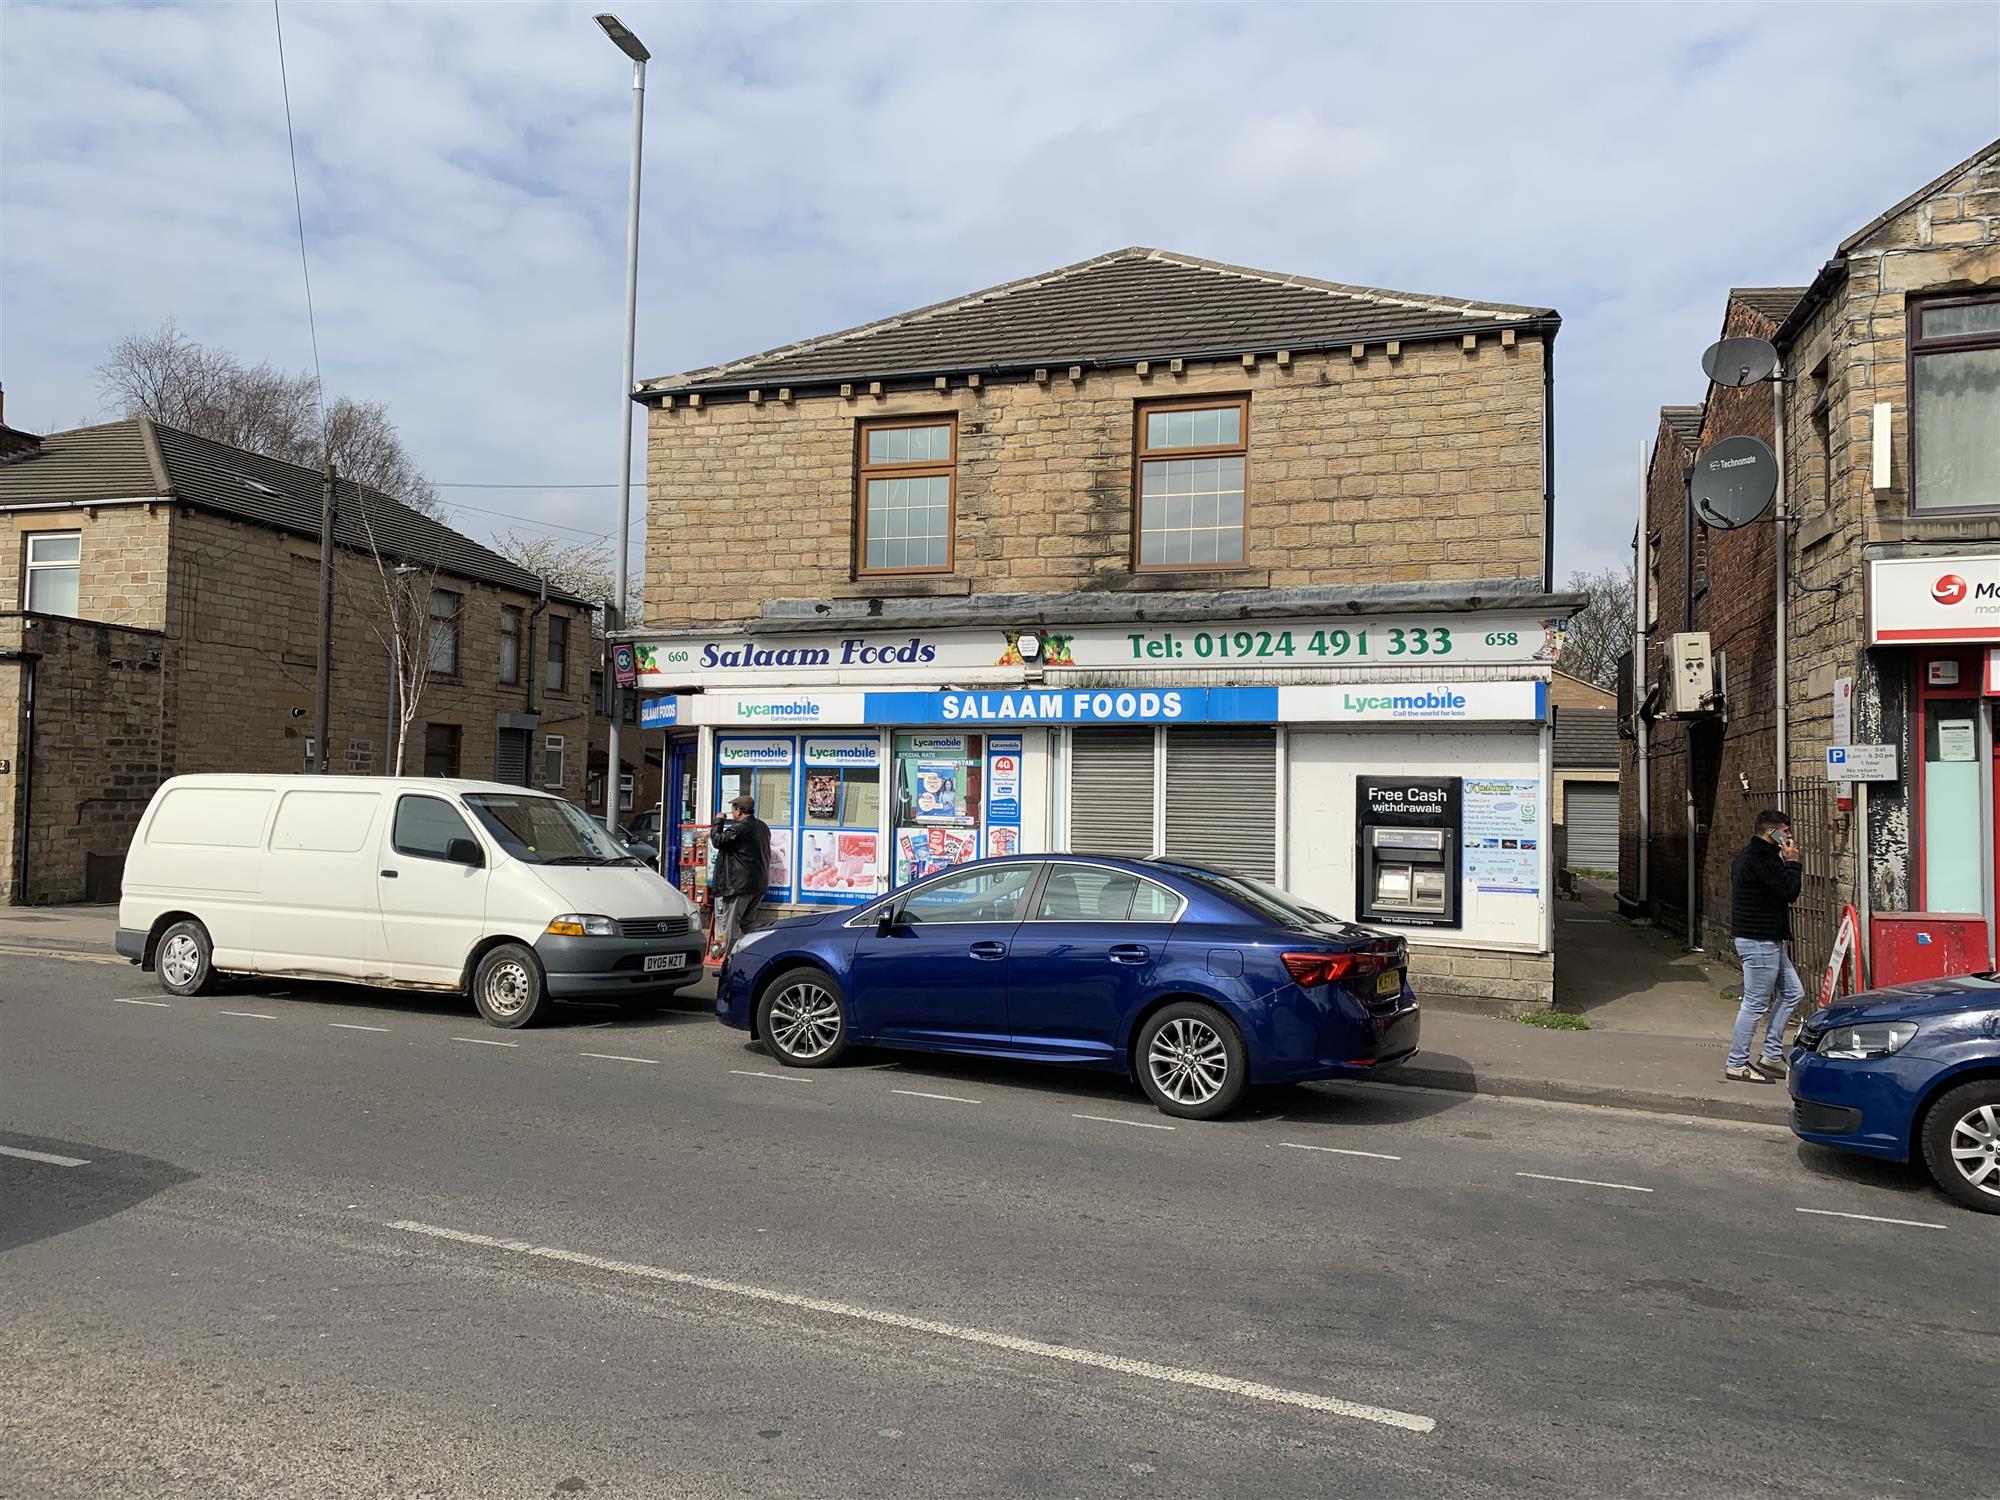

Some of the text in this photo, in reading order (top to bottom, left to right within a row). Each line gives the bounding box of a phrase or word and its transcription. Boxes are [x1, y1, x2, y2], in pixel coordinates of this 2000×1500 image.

[1720, 456, 1756, 468] Technomate
[1128, 628, 1452, 658] Tel: 01924 491 333
[1485, 632, 1518, 646] 658
[668, 652, 688, 662] 660
[700, 638, 936, 668] Salaam Foods
[738, 701, 820, 717] Lycamobile
[943, 692, 1182, 720] SALAAM FOODS
[1344, 692, 1466, 713] Lycamobile
[642, 704, 676, 722] SALAAM FOODS
[914, 739, 961, 748] Lycamobile
[725, 748, 787, 759] Lycamobile
[810, 747, 876, 760] Lycamobile
[1368, 787, 1447, 801] Free Cash
[1372, 802, 1442, 813] withdrawals
[648, 957, 667, 969] DY05
